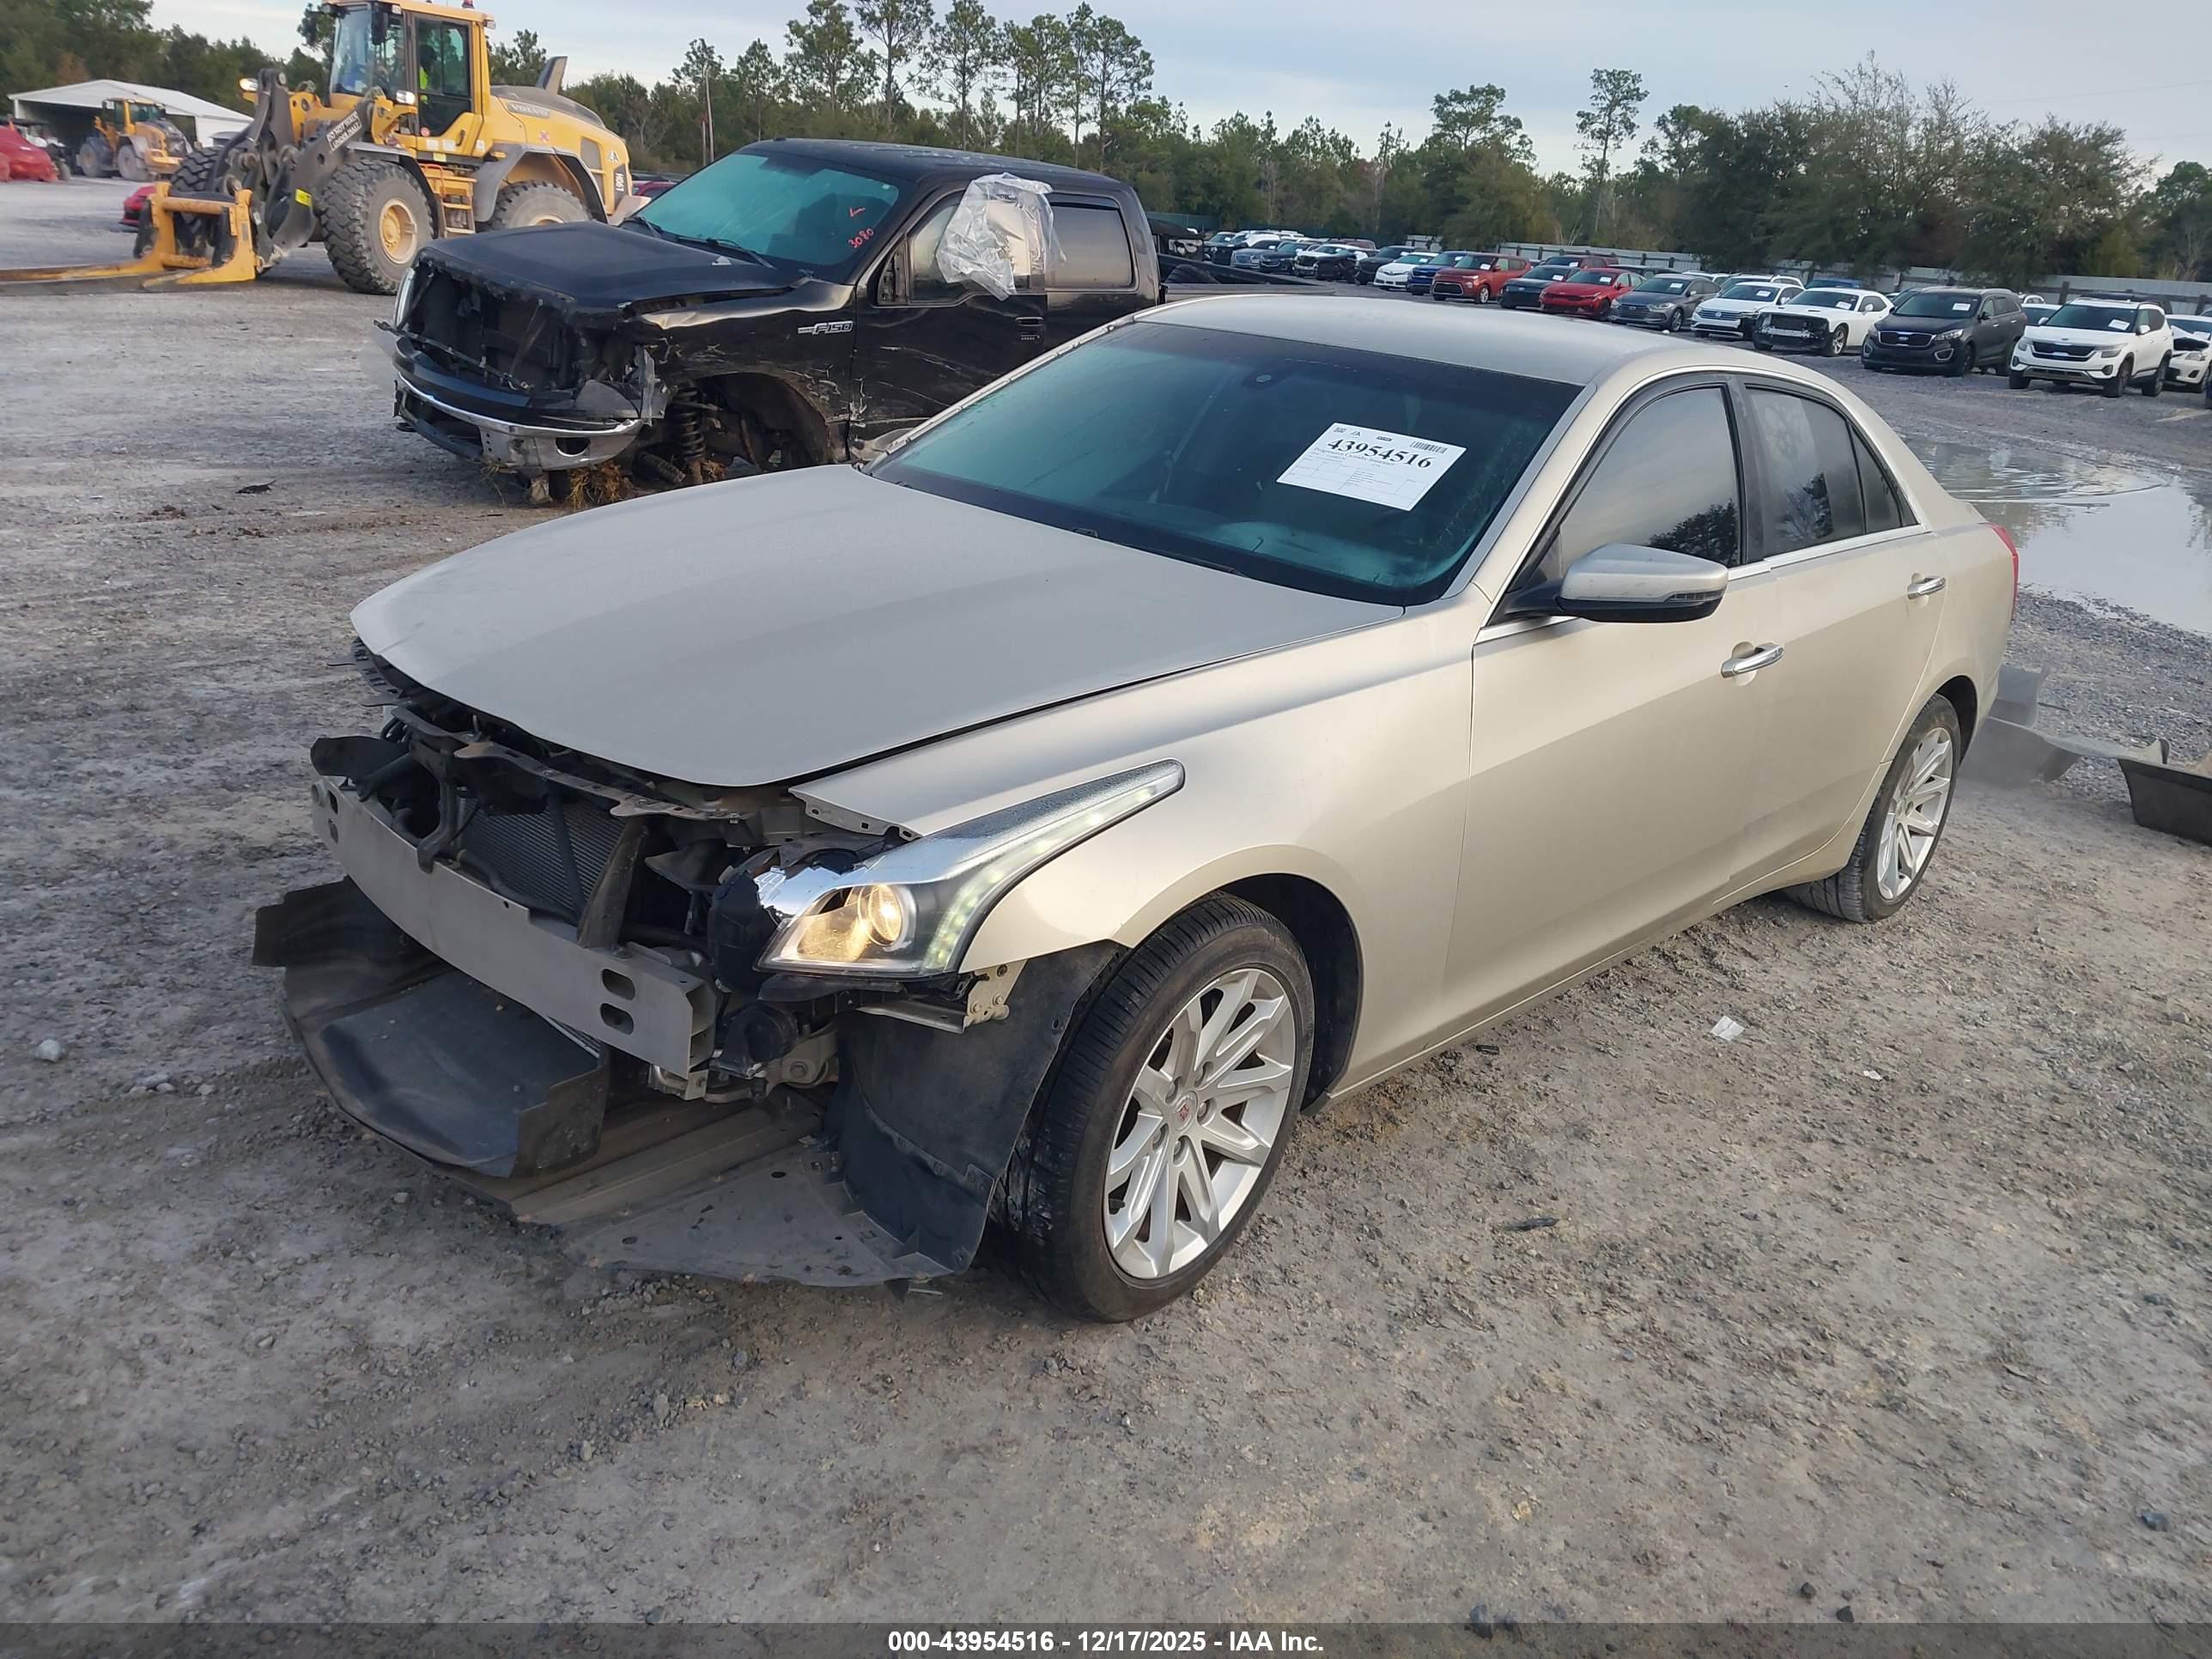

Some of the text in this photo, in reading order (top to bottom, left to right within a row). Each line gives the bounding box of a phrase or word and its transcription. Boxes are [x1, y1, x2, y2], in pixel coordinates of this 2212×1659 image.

[510, 102, 550, 117] VOLVO
[848, 228, 874, 249] 3080
[1328, 439, 1437, 469] 43954516
